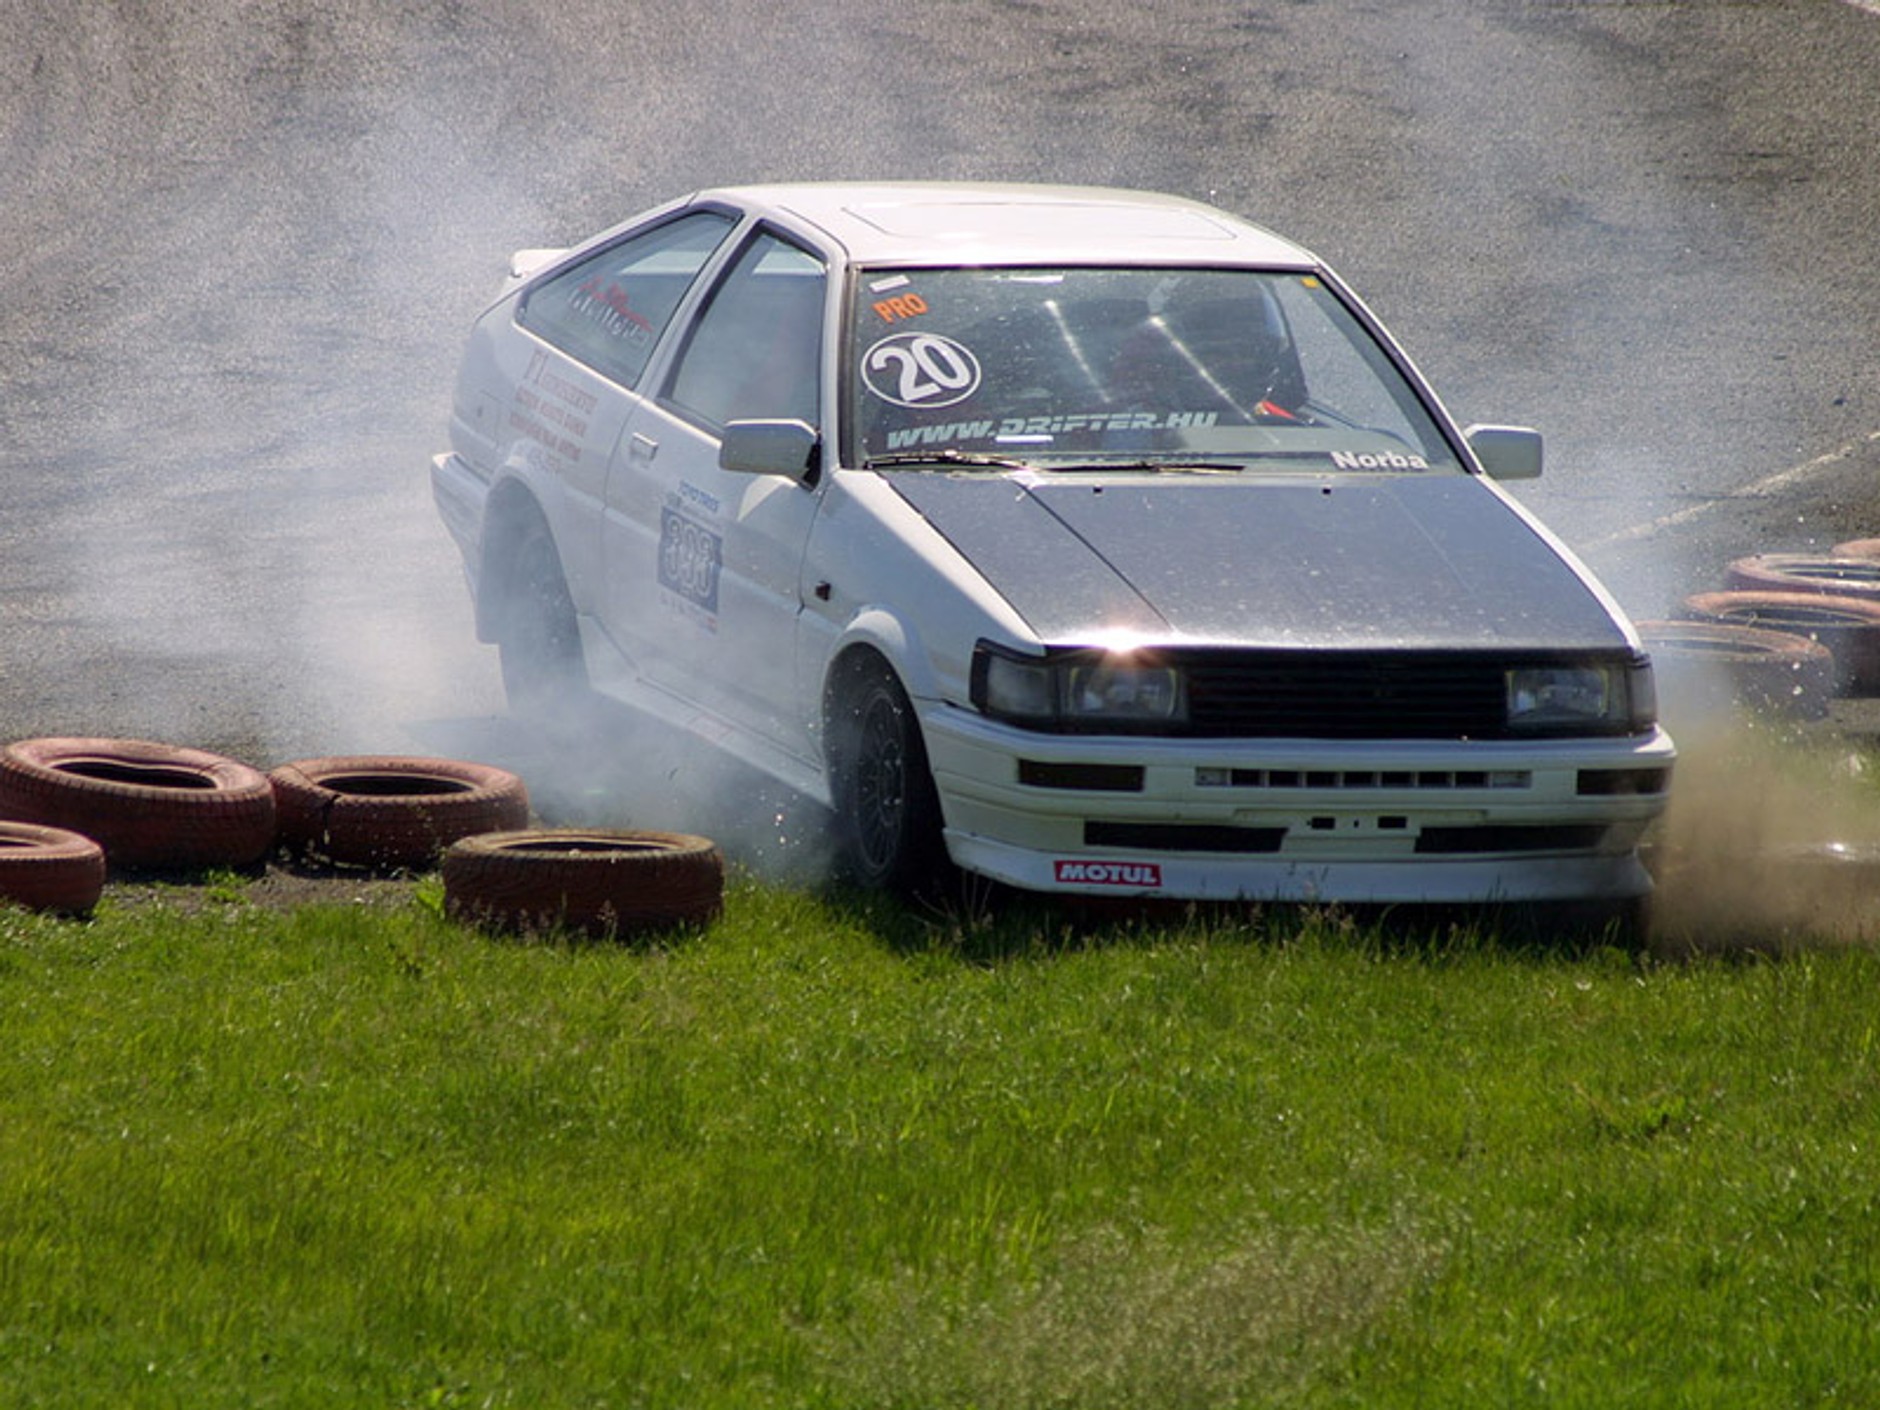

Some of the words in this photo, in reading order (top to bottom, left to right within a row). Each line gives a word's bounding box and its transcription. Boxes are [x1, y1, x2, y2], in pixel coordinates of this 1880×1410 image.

[872, 292, 928, 324] PRO
[871, 337, 971, 401] 20
[1330, 450, 1430, 470] Norba
[1060, 864, 1157, 883] MOTUL
